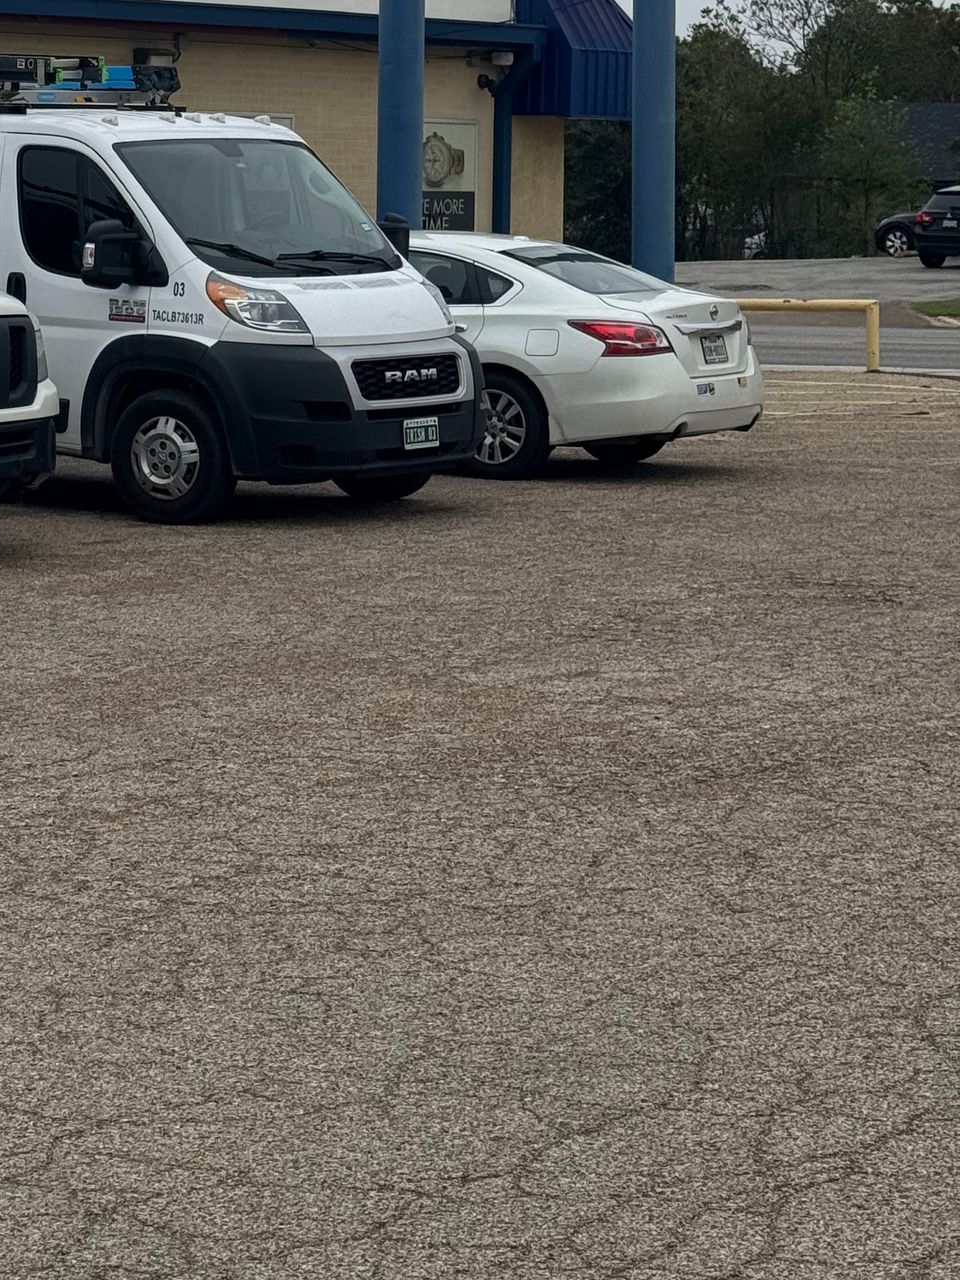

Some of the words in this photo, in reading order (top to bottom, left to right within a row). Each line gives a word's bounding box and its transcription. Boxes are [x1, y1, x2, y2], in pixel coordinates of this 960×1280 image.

[432, 198, 465, 215] MORE
[173, 281, 186, 297] 03
[152, 310, 205, 325] TACLB73613R
[384, 368, 438, 383] RAM
